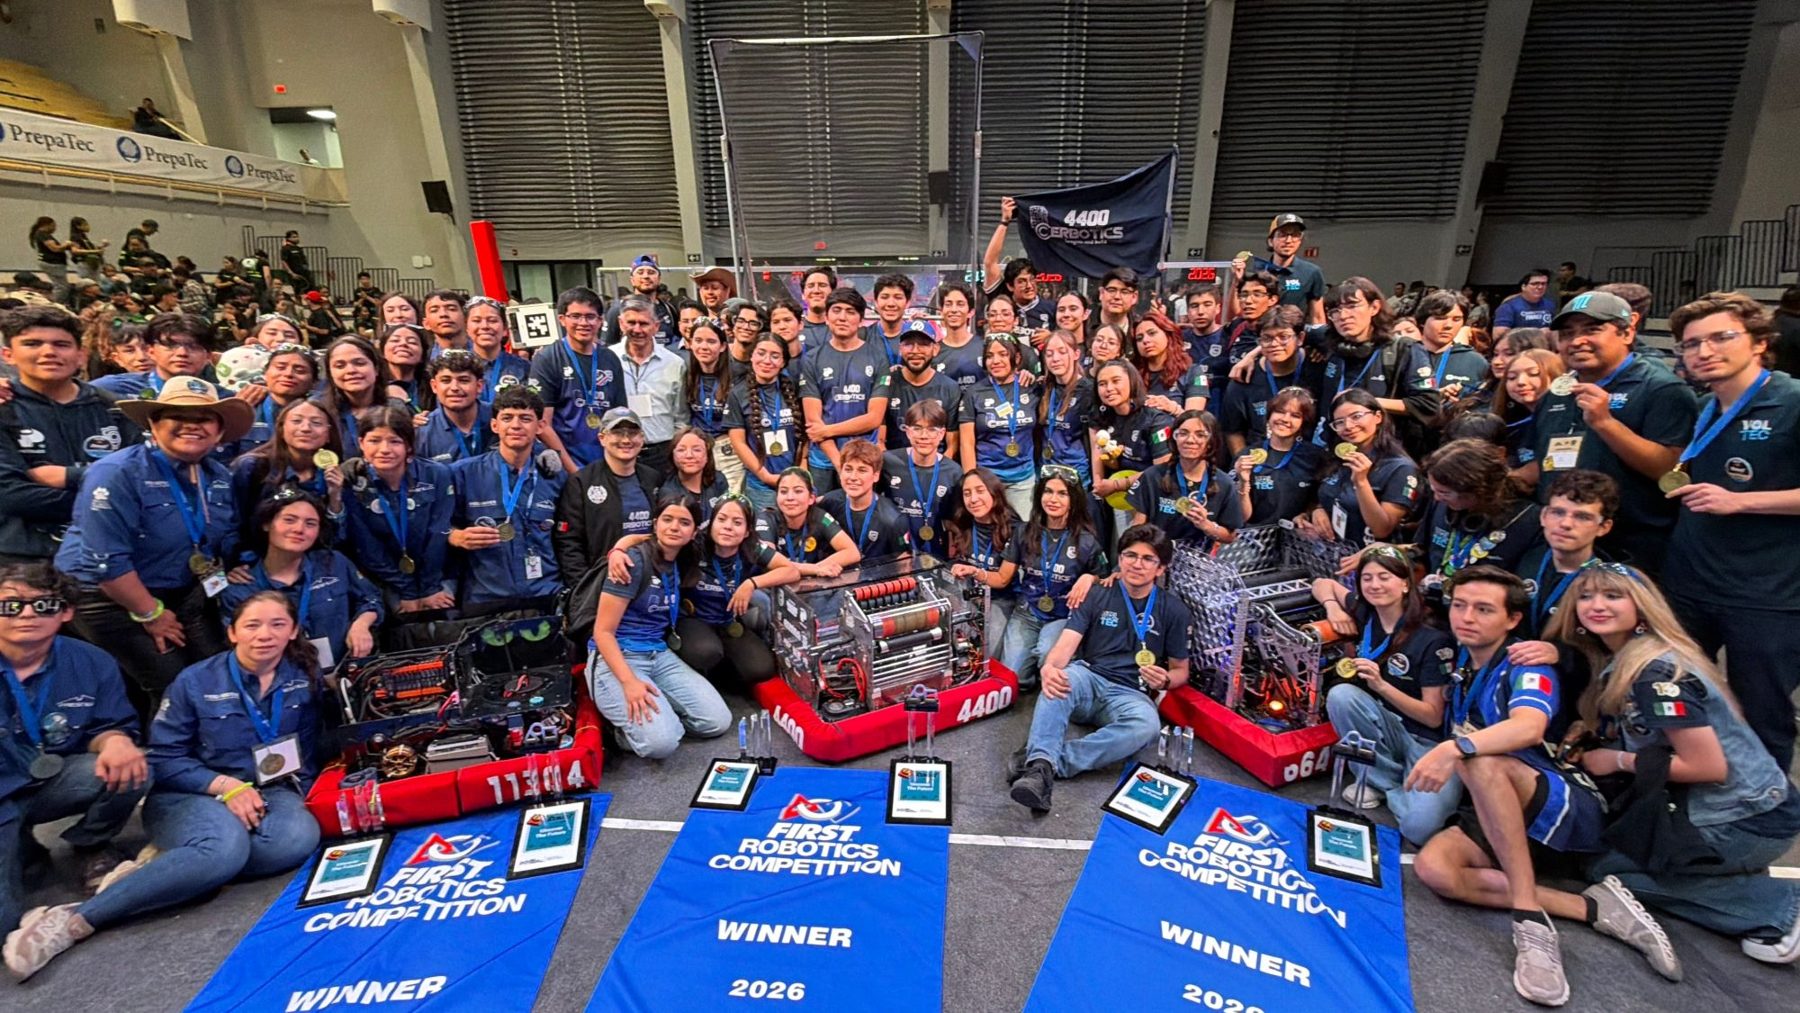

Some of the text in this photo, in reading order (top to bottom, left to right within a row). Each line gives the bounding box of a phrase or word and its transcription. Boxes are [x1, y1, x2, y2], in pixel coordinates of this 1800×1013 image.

[9, 124, 96, 153] PrepaTec
[145, 146, 208, 170] PrepaTec
[246, 163, 296, 184] PrepaTec
[1064, 209, 1110, 227] 4400
[1035, 222, 1123, 240] CERBOTICS
[1739, 429, 1771, 440] TEC
[1742, 420, 1772, 430] VOL
[1254, 482, 1274, 490] TEC
[1159, 504, 1177, 514] TEC
[623, 520, 652, 529] ERBOTIC
[1100, 618, 1119, 628] TEC
[957, 686, 1012, 723] 4400
[773, 706, 804, 750] 4400
[767, 822, 861, 841] FIRST
[738, 838, 879, 859] ROBOTICS
[1194, 834, 1290, 869] FIRST
[384, 858, 493, 887] FIRST
[708, 854, 901, 876] COMPETITION
[1138, 849, 1346, 928] COMPETITION
[304, 893, 527, 932] COMPETITION
[717, 919, 852, 947] WINNER
[1160, 920, 1311, 988] WINNER
[285, 975, 447, 1013] WINNER
[728, 979, 805, 1001] 2026
